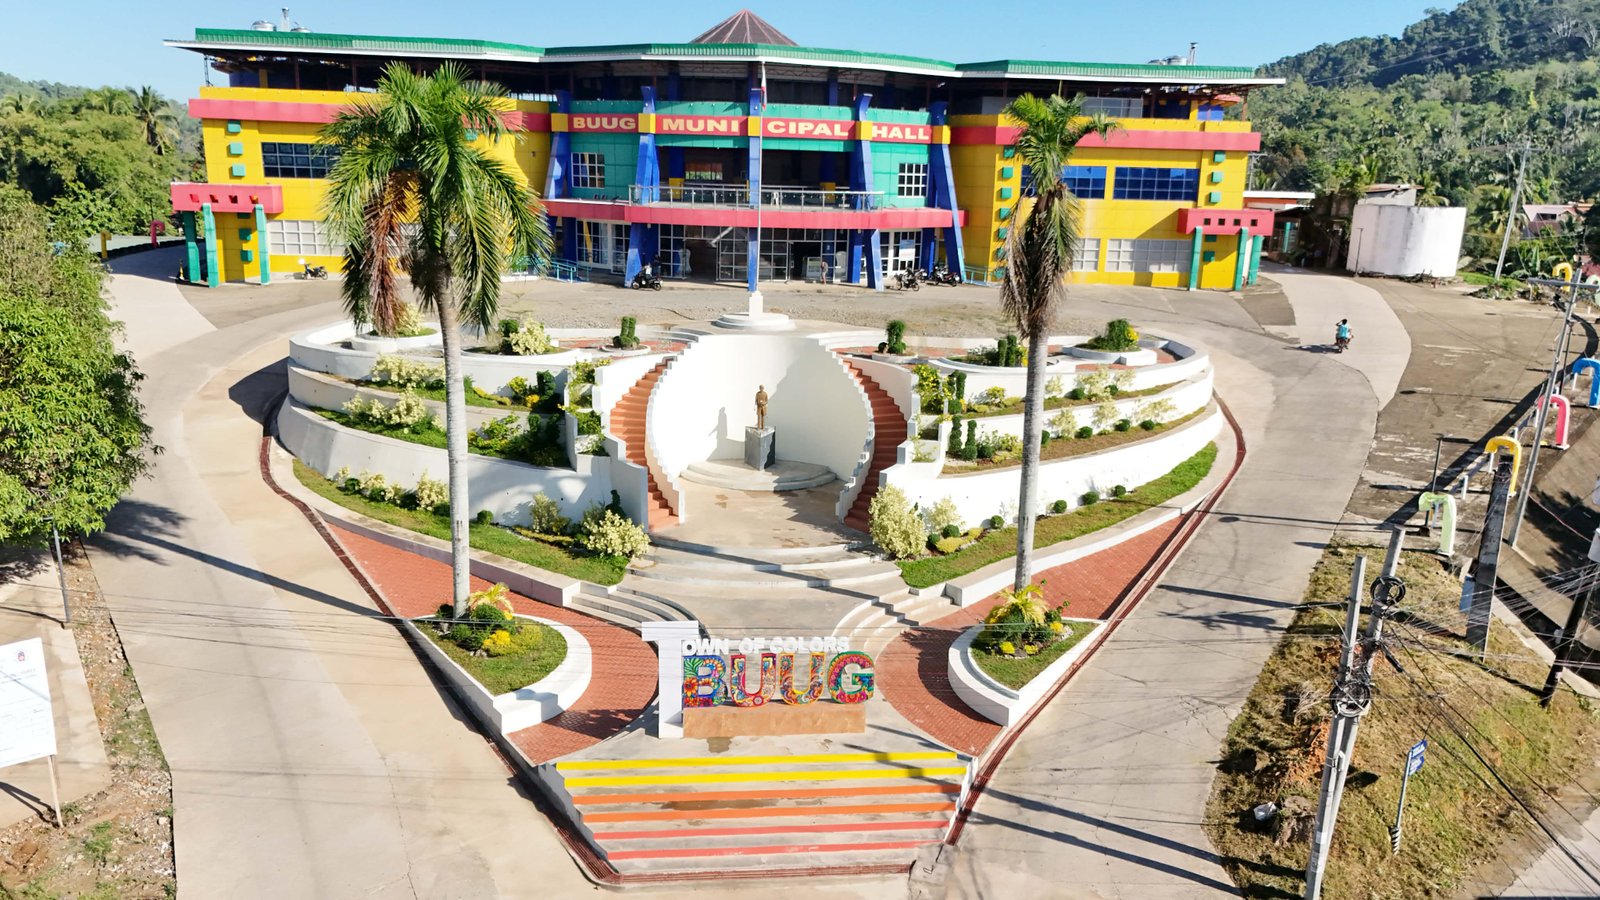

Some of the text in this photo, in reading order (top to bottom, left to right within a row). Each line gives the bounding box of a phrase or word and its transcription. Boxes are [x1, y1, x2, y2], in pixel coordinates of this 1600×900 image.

[573, 117, 929, 140] BUUG MUNI CIPAL HALL
[739, 637, 766, 654] OF
[770, 636, 849, 654] COLORS
[682, 650, 875, 708] BUUG
